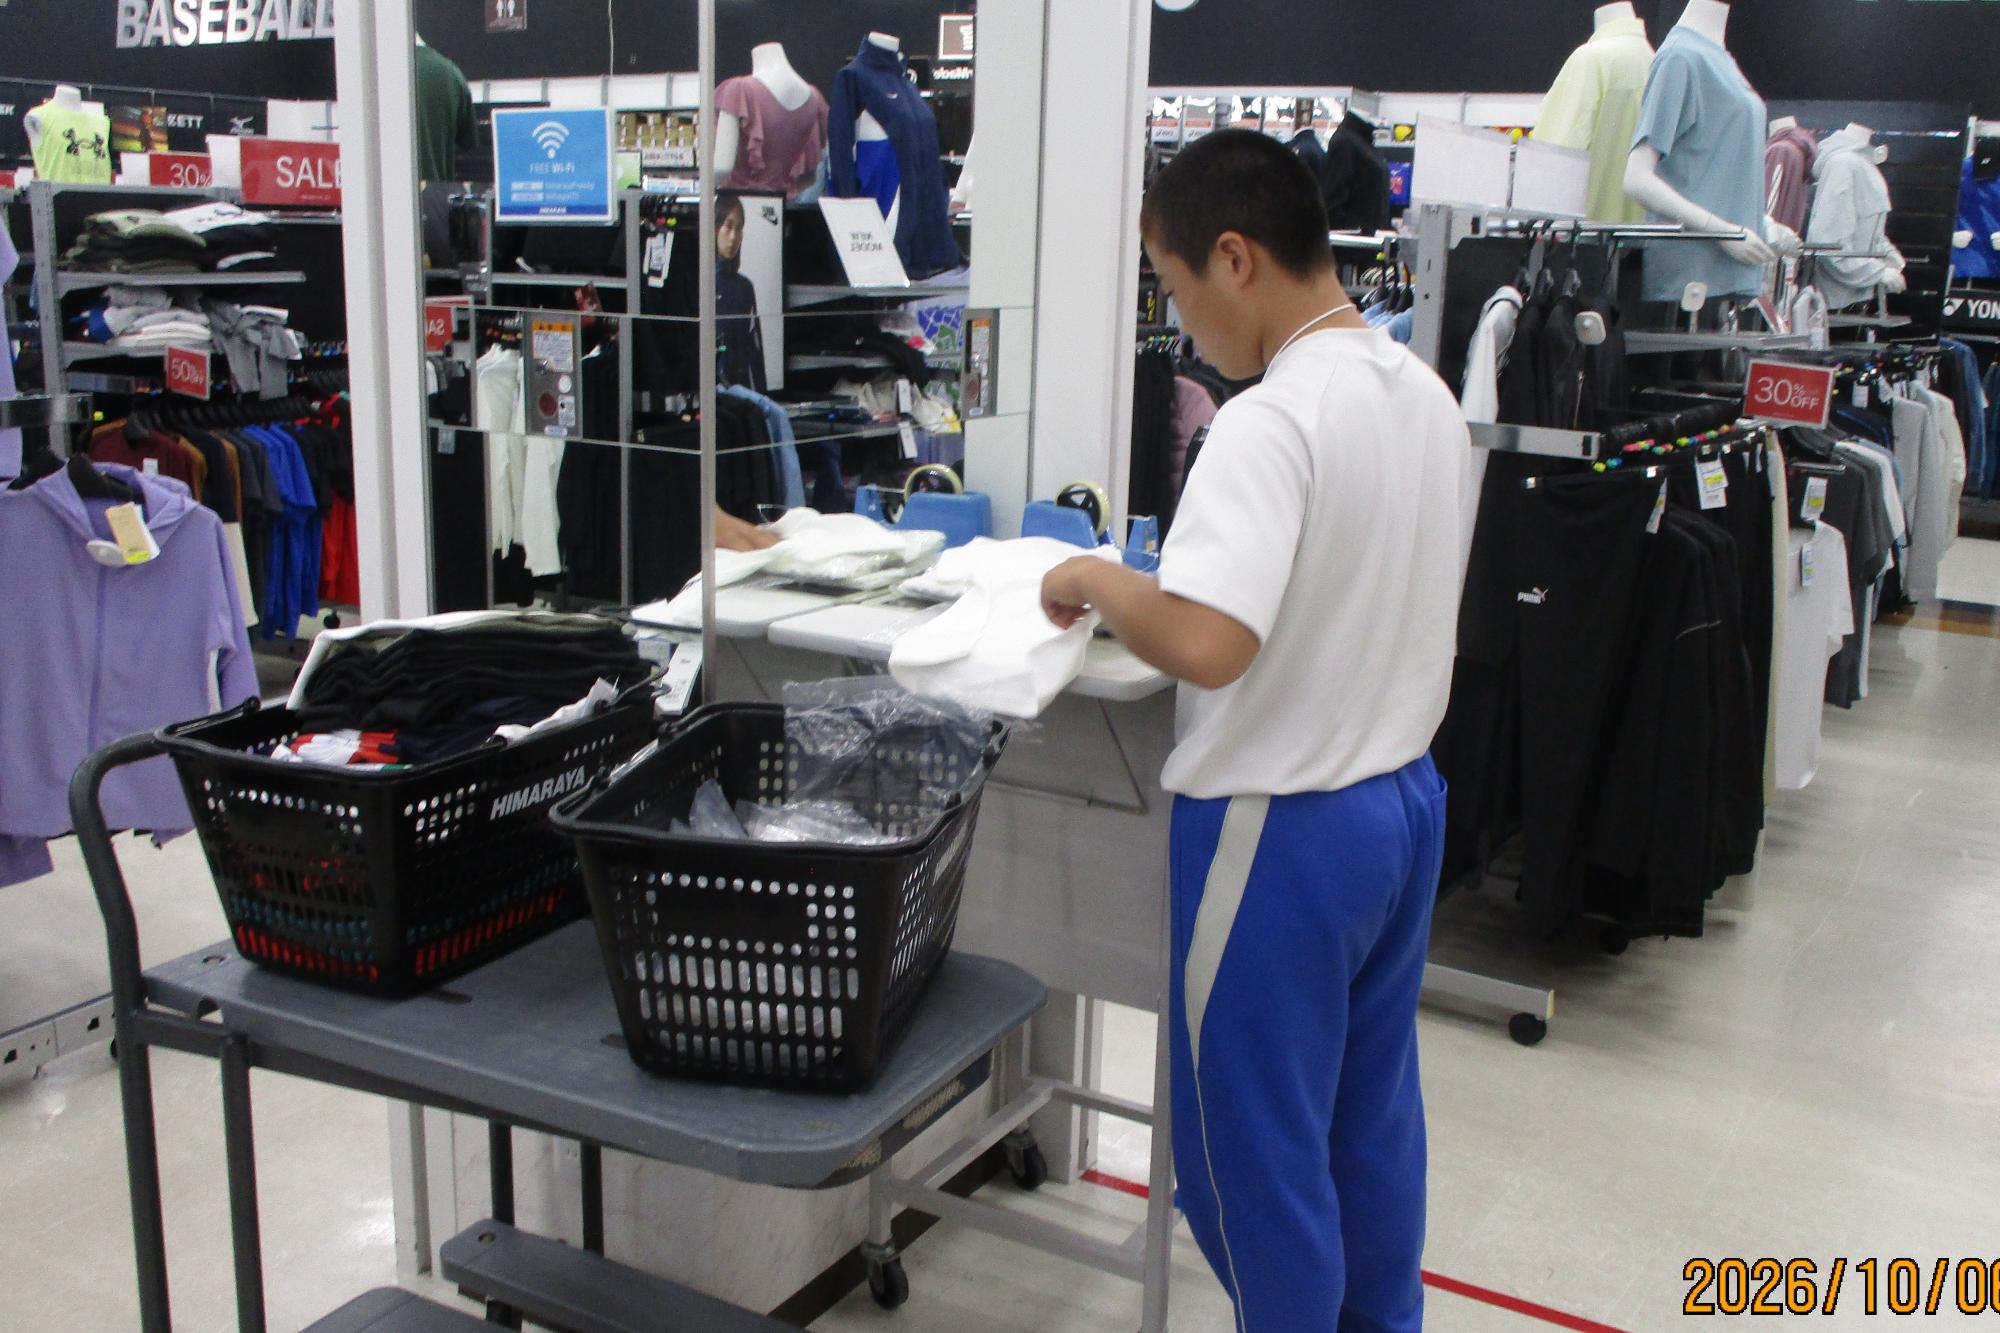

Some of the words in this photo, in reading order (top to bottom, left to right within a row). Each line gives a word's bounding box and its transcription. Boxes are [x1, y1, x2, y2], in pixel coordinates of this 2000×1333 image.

[116, 0, 334, 48] BASEBALL
[1791, 396, 1820, 410] OFF
[490, 765, 584, 820] HIMARAYA
